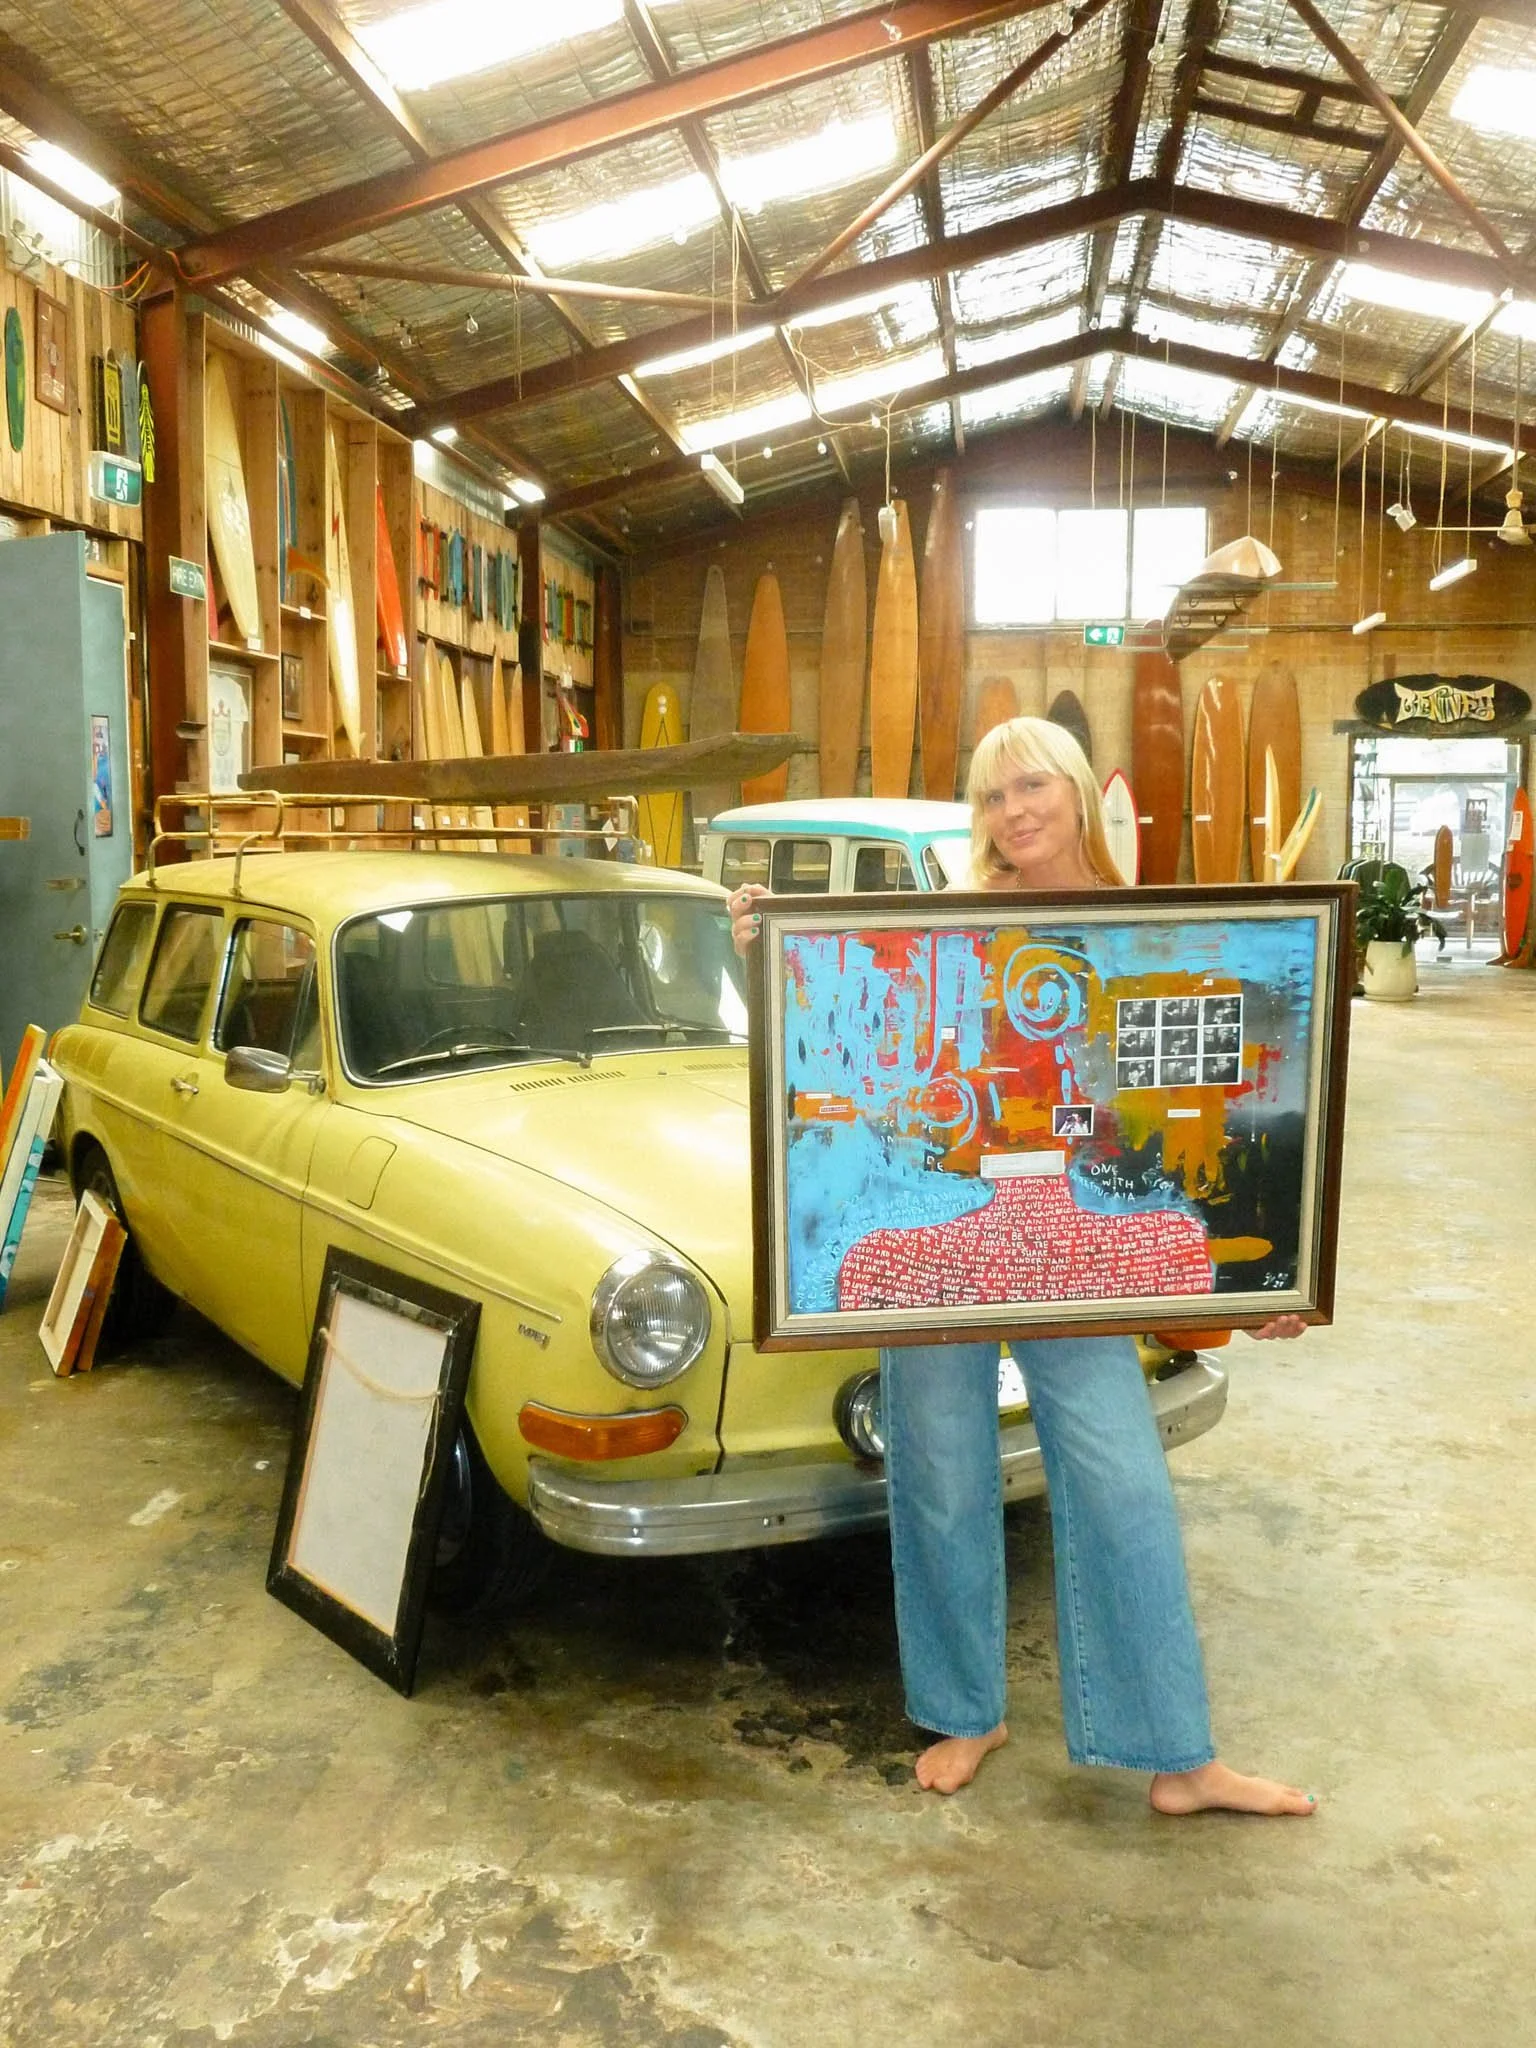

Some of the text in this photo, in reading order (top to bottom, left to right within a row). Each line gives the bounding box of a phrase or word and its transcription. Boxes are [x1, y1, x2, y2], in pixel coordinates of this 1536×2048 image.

[1091, 1163, 1118, 1175] ONE
[1102, 1177, 1134, 1189] WITH
[961, 1229, 980, 1240] AND
[1011, 1231, 1024, 1241] BE
